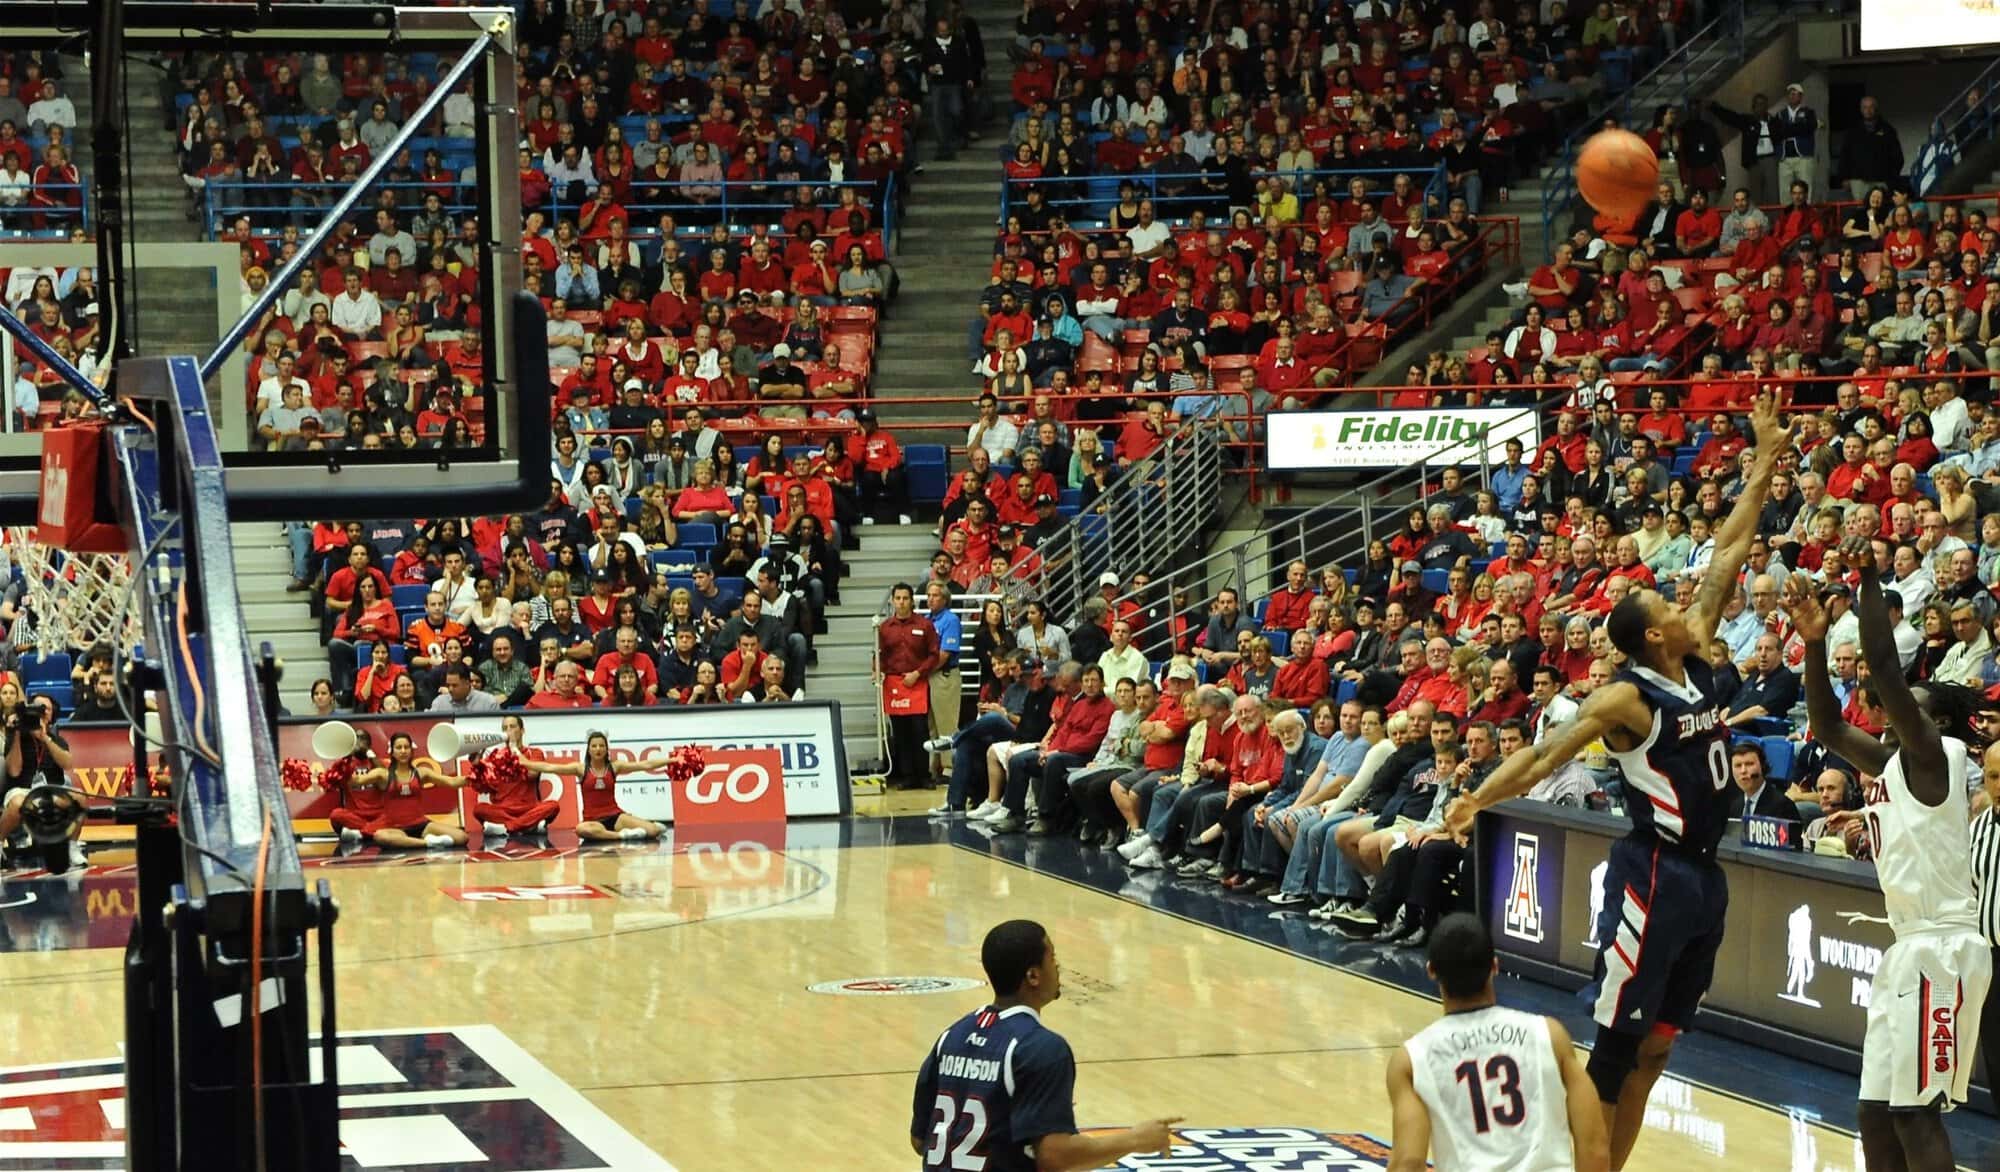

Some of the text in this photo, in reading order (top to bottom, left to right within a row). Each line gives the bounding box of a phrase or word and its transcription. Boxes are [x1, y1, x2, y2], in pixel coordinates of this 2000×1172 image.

[1337, 415, 1490, 448] Fidelity
[685, 762, 770, 805] GO
[1708, 739, 1730, 791] 0
[1749, 820, 1780, 848] POSS.
[1504, 831, 1542, 943] A
[1931, 1007, 1954, 1074] CATS
[939, 1054, 1001, 1083] JOHNSON
[1455, 1053, 1527, 1135] 13
[926, 1093, 988, 1172] 32
